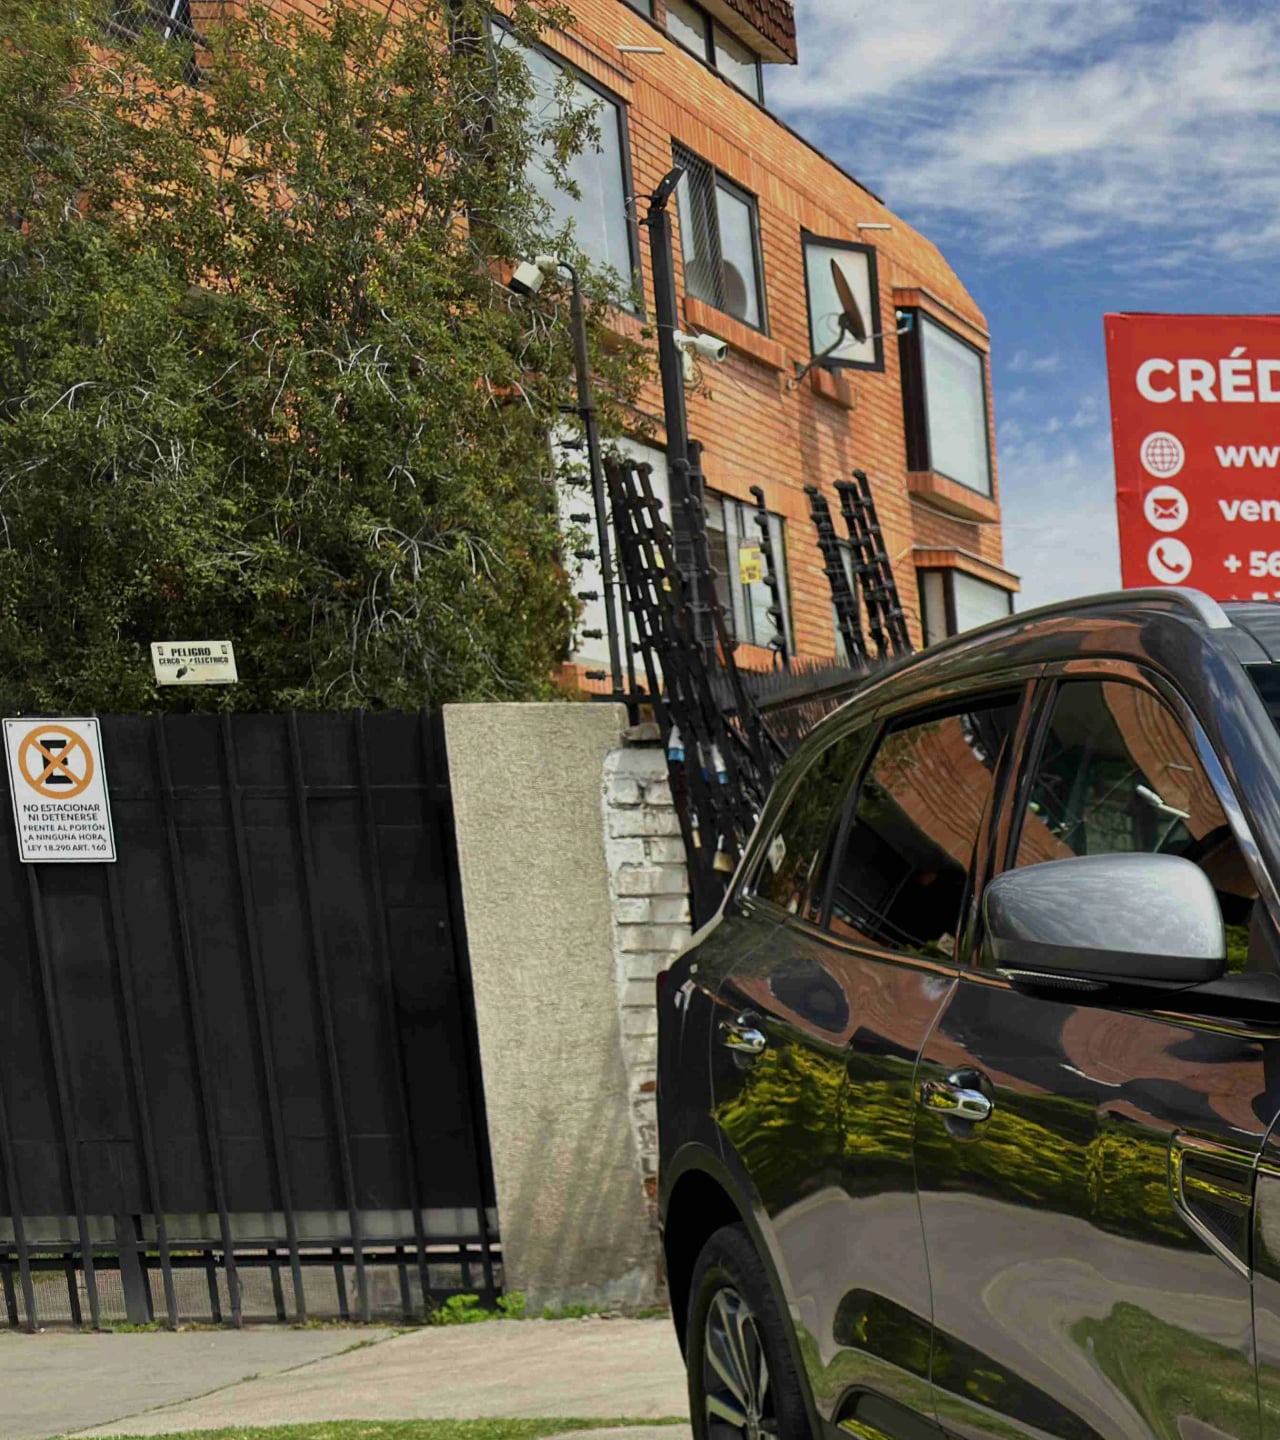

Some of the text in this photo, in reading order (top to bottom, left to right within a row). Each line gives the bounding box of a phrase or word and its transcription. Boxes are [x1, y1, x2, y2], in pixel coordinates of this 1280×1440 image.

[171, 647, 211, 657] PELIGRO
[23, 803, 101, 812] NO ESTACIONAR
[28, 812, 99, 821] NI DETENERSE
[24, 824, 55, 832] FRENTE
[69, 822, 106, 831] PORTÓN
[28, 833, 104, 841] A NINGUNA HORA
[28, 844, 41, 852] LEY
[92, 843, 107, 851] 160
